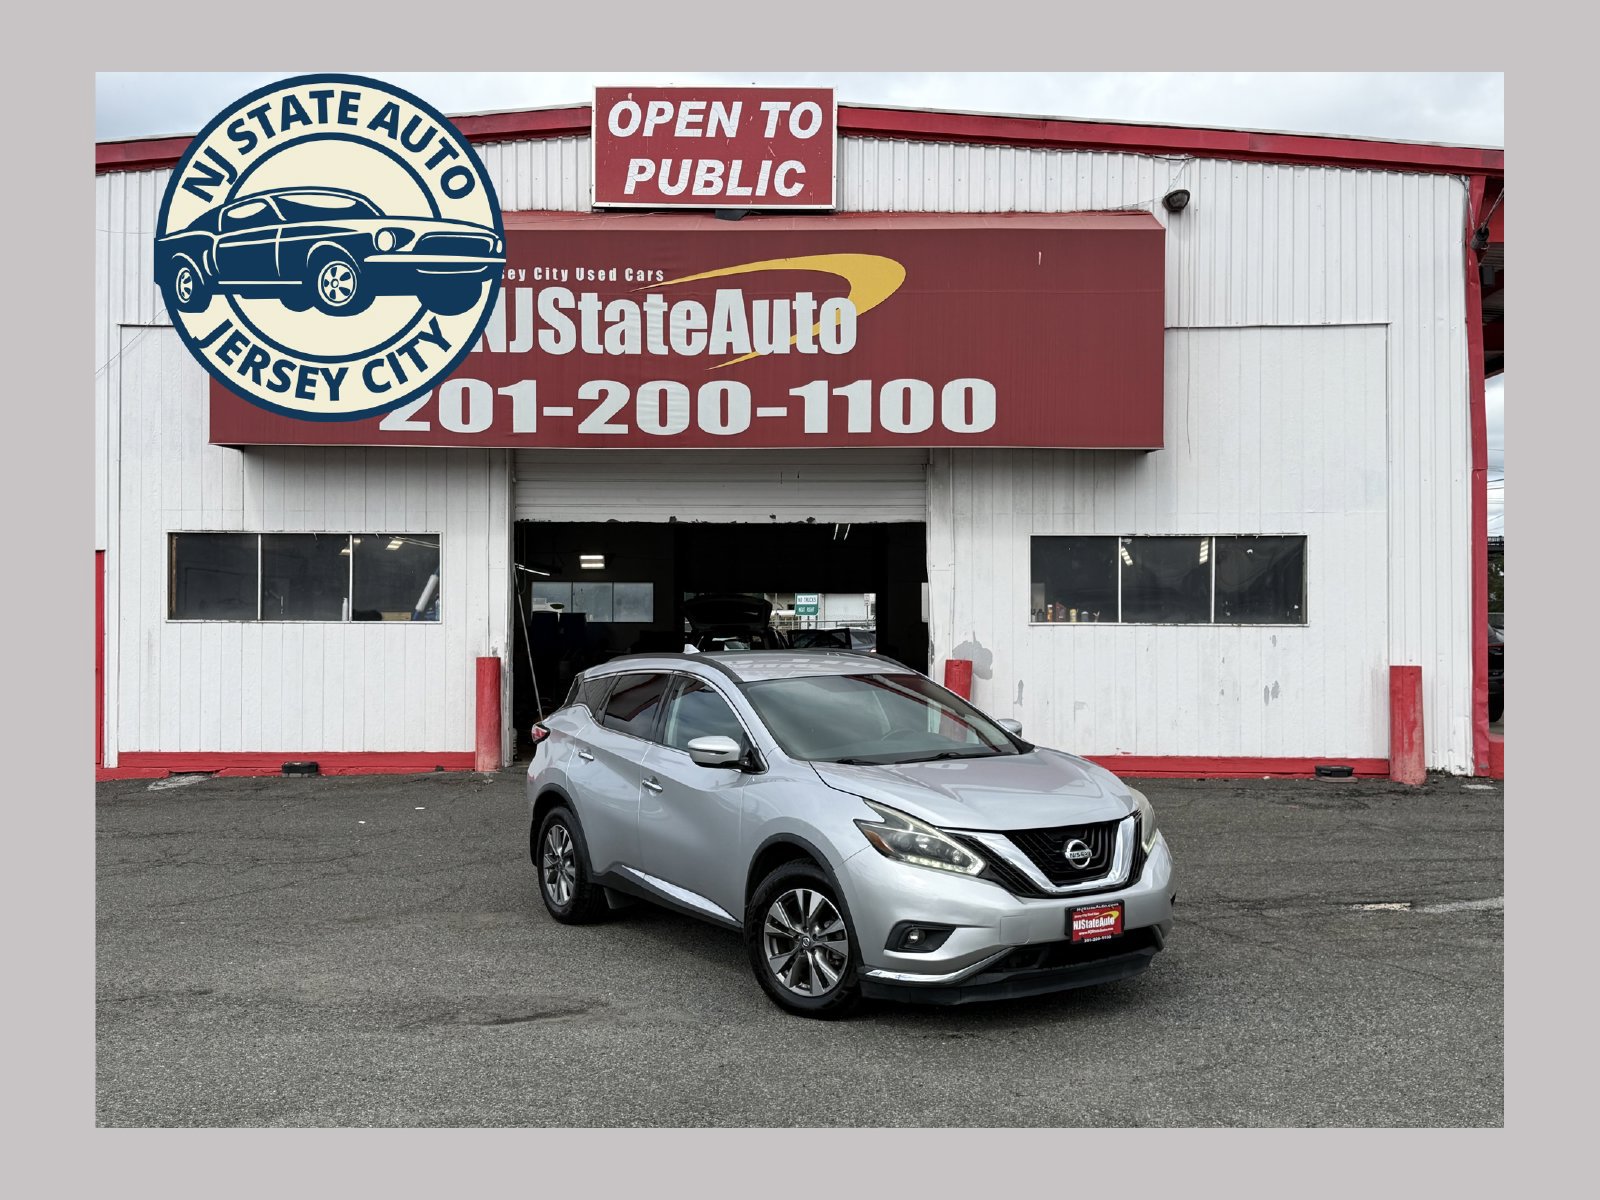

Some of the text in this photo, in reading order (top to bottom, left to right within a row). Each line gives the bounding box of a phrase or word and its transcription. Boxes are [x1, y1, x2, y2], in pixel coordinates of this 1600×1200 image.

[607, 100, 823, 139] OPEN TO
[623, 158, 807, 198] PUBLIC
[533, 266, 569, 282] City
[575, 267, 617, 282] Used
[624, 267, 664, 282] Cars
[472, 286, 858, 356] NJStateAuto
[379, 378, 997, 436] 201-200-1100
[1073, 916, 1115, 930] NJStateAuto
